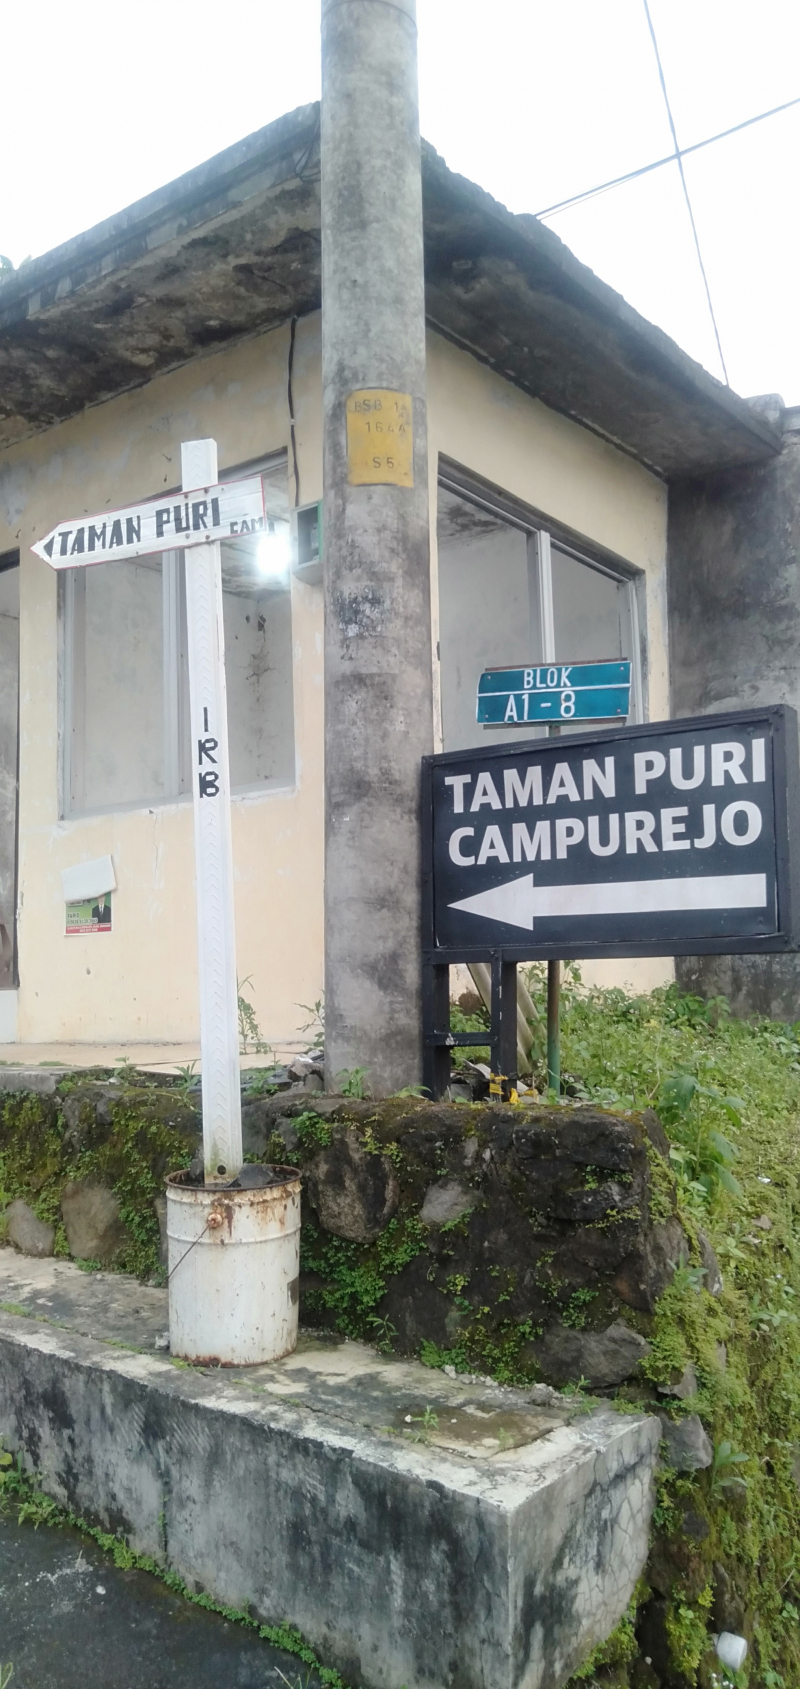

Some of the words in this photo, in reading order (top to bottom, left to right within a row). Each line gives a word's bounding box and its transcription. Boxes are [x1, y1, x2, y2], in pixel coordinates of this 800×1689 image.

[354, 399, 383, 413] BSB
[58, 515, 141, 557] TAMAN
[155, 497, 221, 539] PURI
[523, 667, 573, 689] BLOK
[444, 756, 616, 814] TAMAN
[633, 738, 767, 795] PURI
[448, 800, 763, 867] CAMPUREJO
